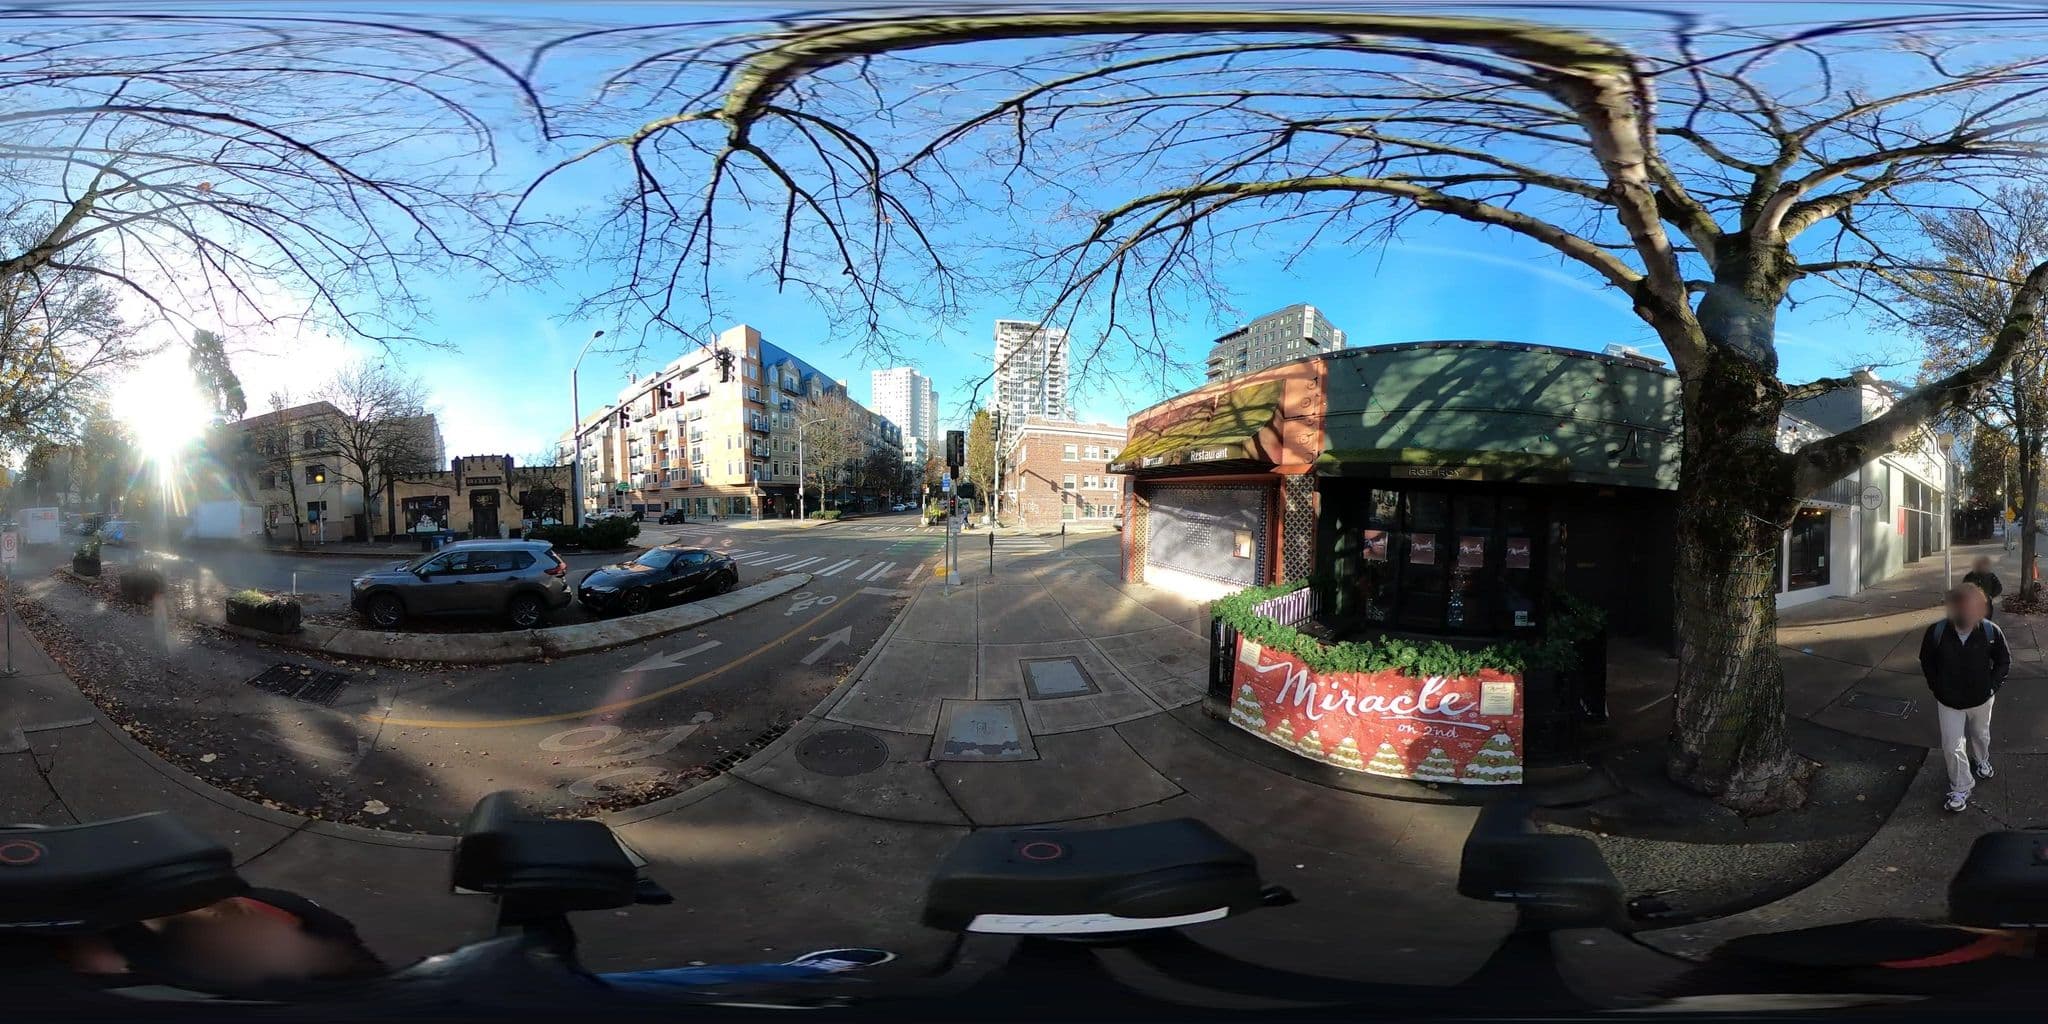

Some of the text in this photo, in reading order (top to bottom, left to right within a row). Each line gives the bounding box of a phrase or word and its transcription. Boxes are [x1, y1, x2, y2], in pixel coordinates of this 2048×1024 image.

[1190, 447, 1228, 462] Restaurant
[1255, 661, 1476, 720] Miracle
[1398, 724, 1459, 740] on 2nd
